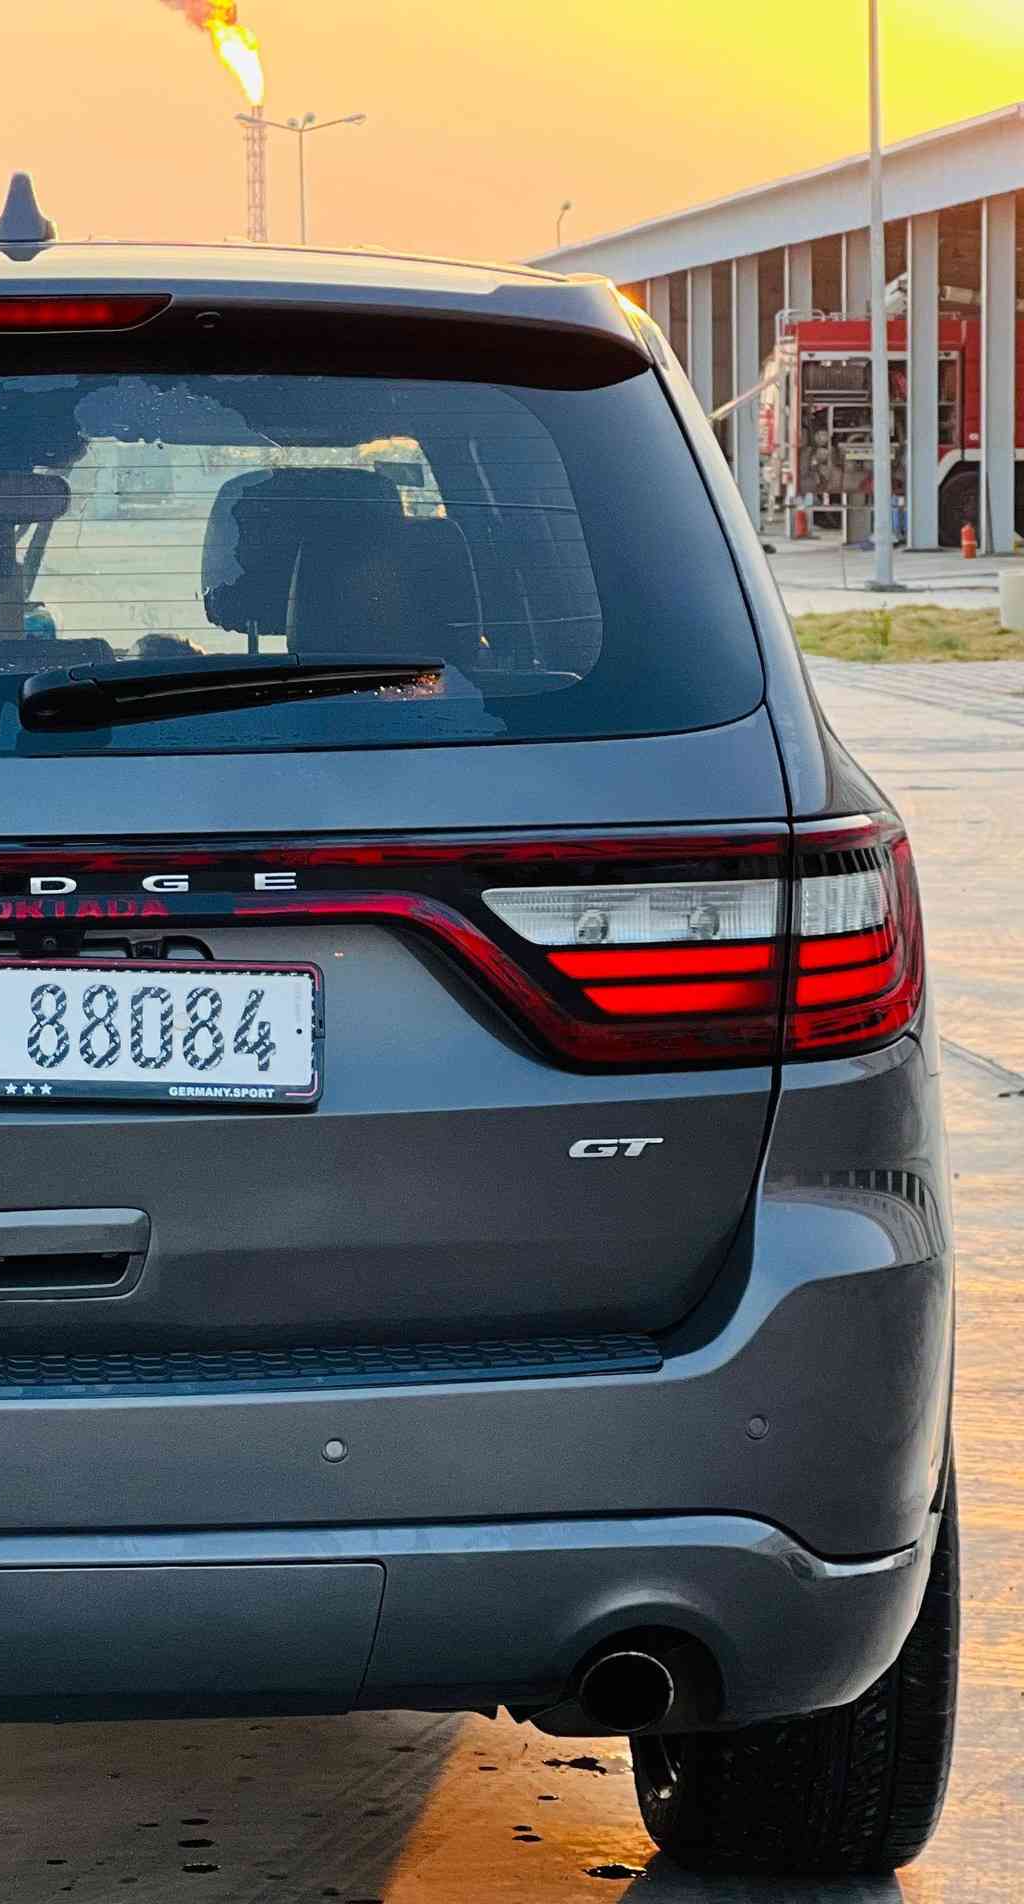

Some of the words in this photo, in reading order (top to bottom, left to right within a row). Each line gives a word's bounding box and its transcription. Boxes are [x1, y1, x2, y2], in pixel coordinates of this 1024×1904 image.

[27, 983, 276, 1072] 88084
[168, 1086, 275, 1099] GERMANY.SPORT
[568, 1137, 664, 1158] GT
